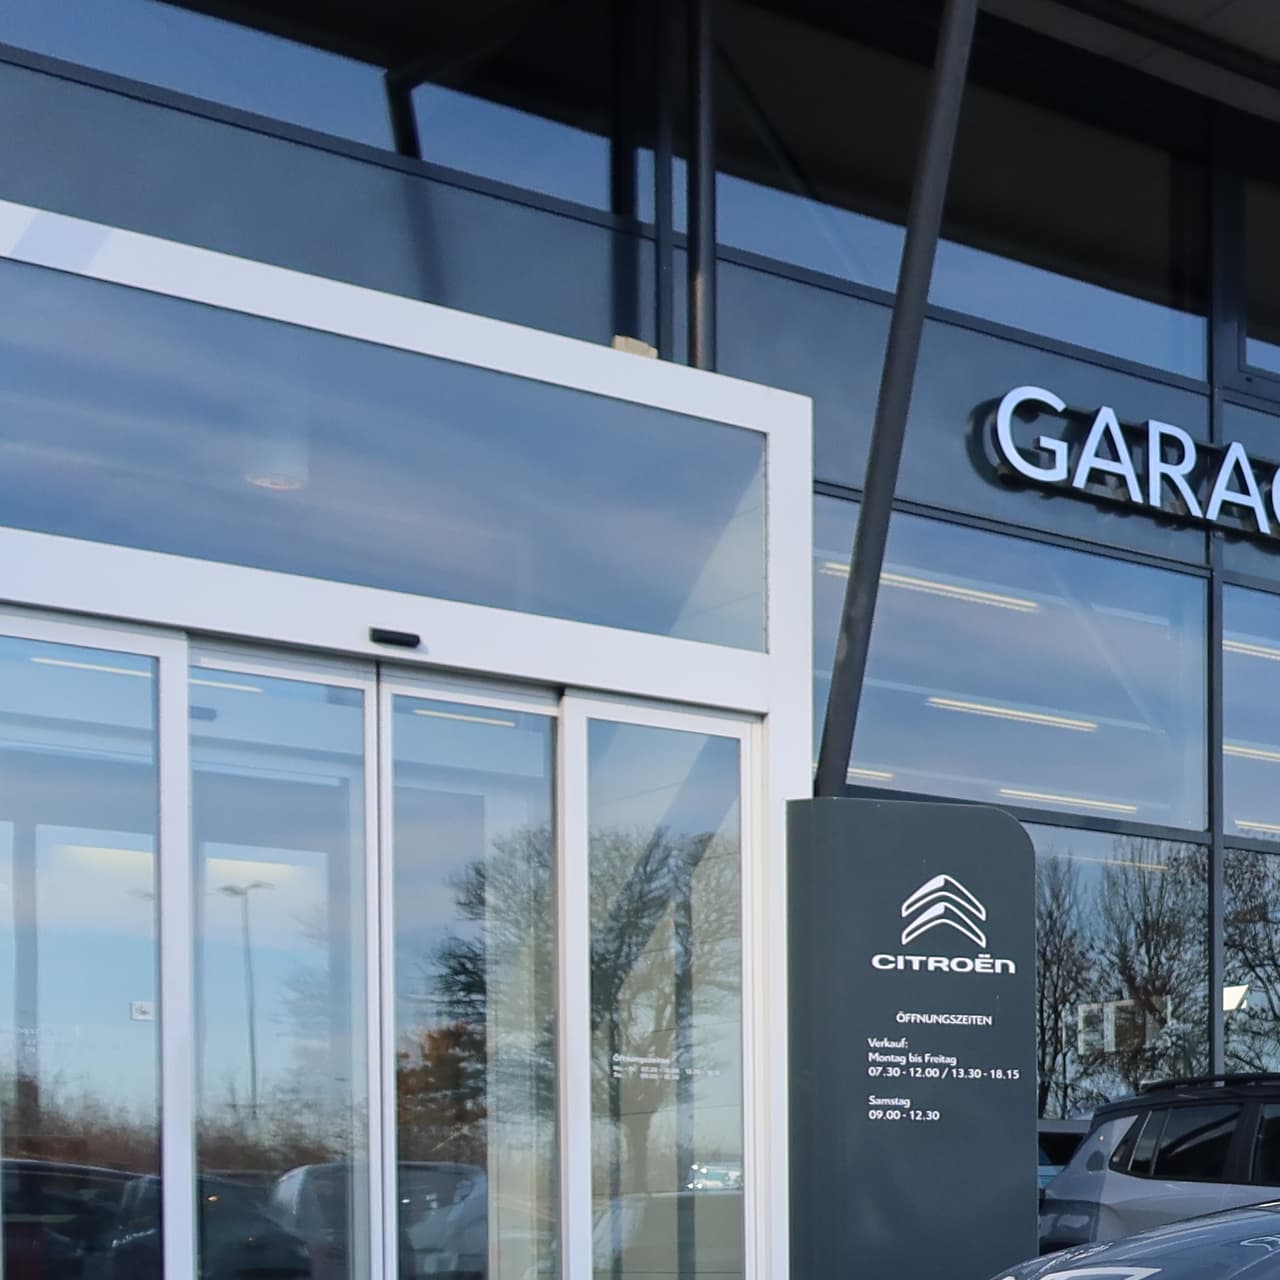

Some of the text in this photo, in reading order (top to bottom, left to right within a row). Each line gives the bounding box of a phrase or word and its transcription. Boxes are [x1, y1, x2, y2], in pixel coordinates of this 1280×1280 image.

[896, 1010, 993, 1026] ÖFFNUNGSZEITEN
[867, 1037, 909, 1049] Verkauf:
[868, 1052, 957, 1066] Montag bis Freitag
[868, 1067, 901, 1077] 07.30
[909, 1067, 940, 1078] 12.00
[951, 1068, 982, 1079] 13.30
[989, 1069, 1020, 1080] 18.15
[868, 1095, 911, 1108] Samstag
[868, 1110, 901, 1120] 09.00
[909, 1110, 941, 1121] 12.30
